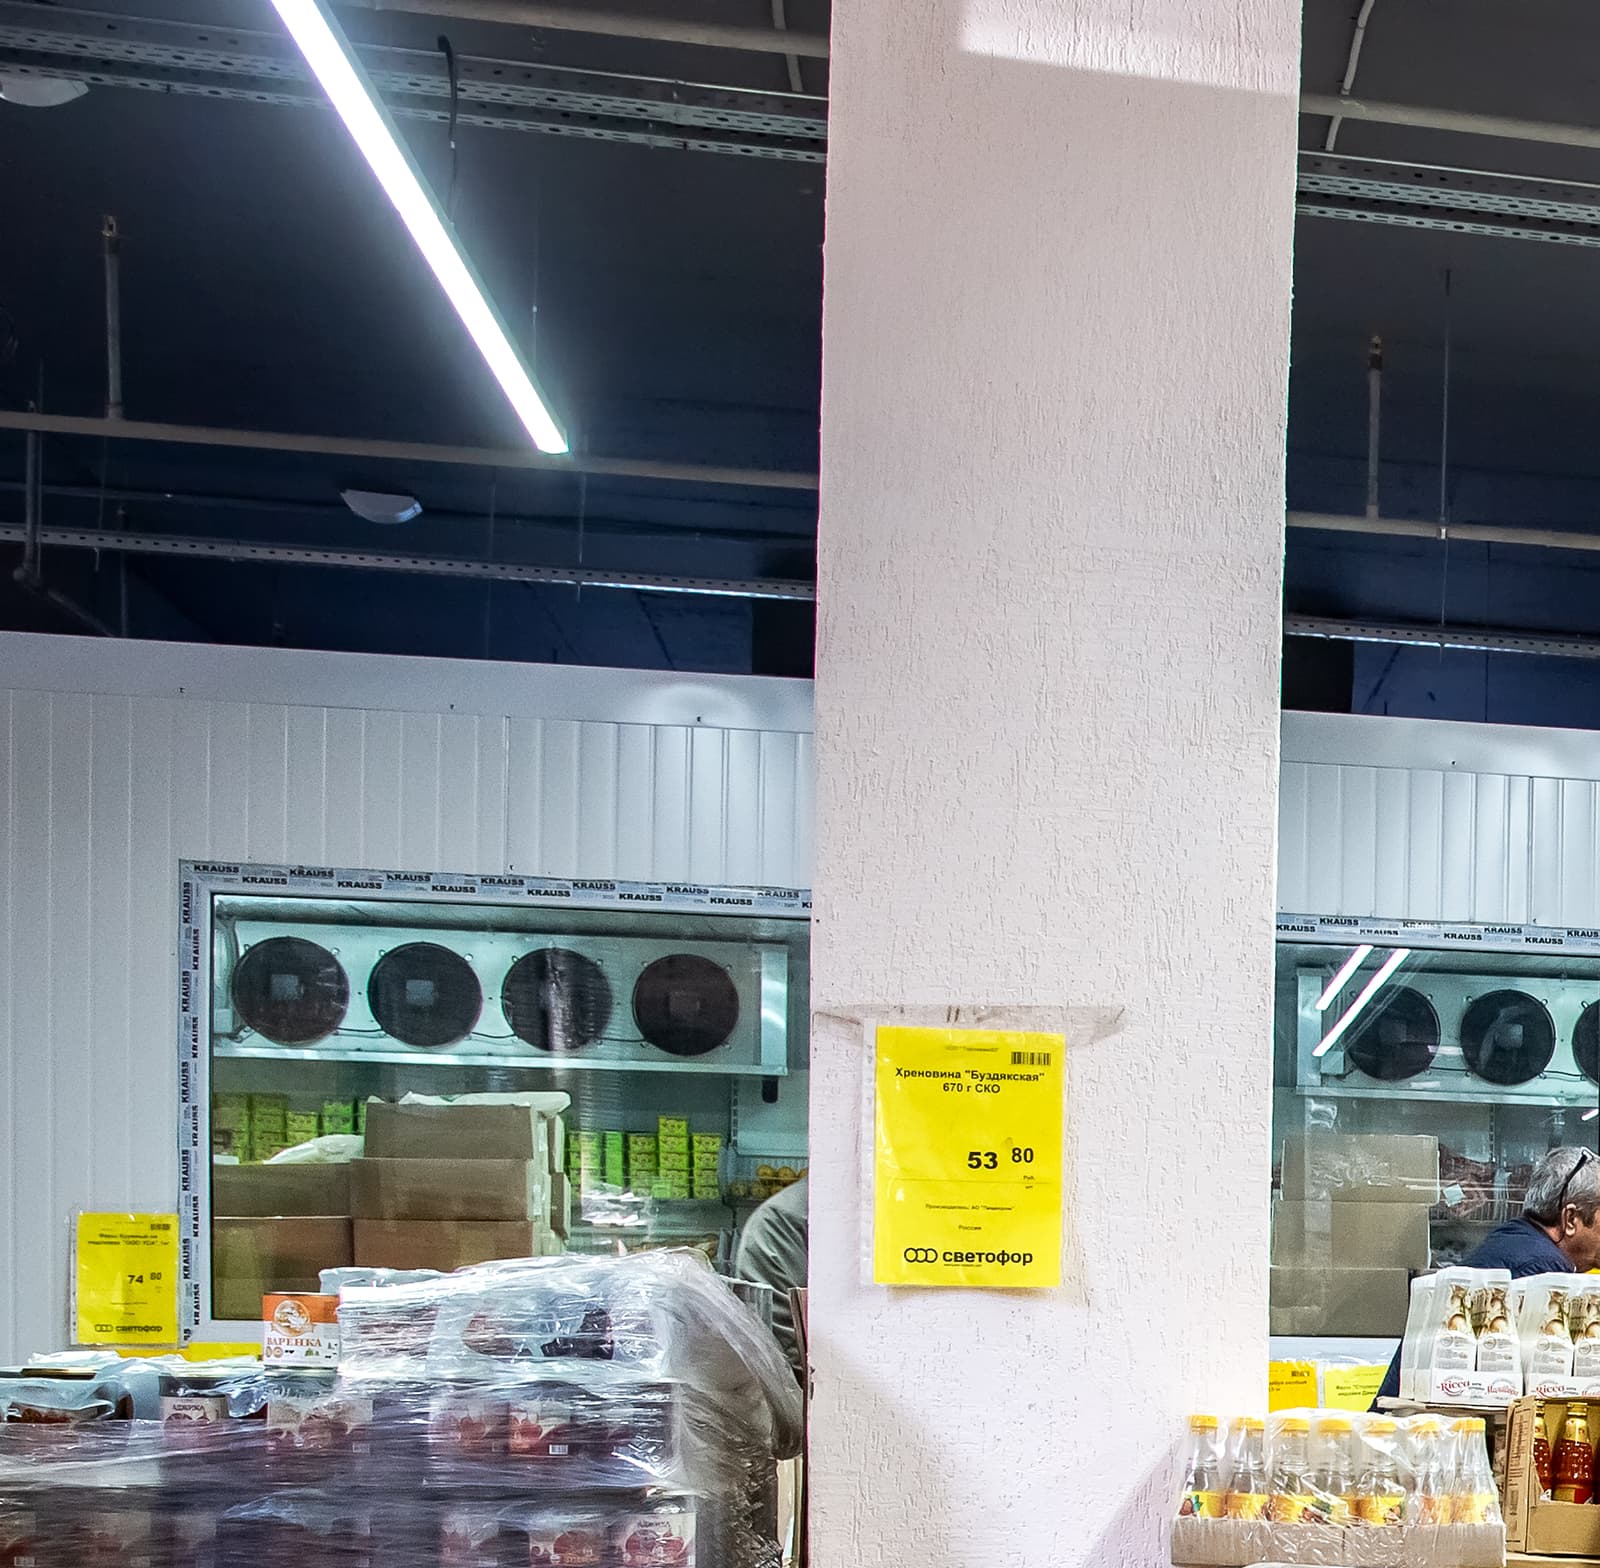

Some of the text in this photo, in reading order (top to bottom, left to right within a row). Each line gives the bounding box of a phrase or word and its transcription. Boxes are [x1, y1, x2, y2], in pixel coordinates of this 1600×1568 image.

[194, 864, 240, 874] KRAUSS
[290, 868, 334, 878] KRAUSS
[242, 876, 288, 885] KRAUSS
[387, 874, 431, 882] KRAUSS
[481, 877, 524, 886] KRAUSS
[338, 880, 382, 889] KRAUSS
[432, 885, 476, 893] KRAUSS
[573, 881, 615, 890] KRAUSS
[527, 889, 570, 897] KRAUSS
[666, 886, 709, 894] KRAUSS
[619, 893, 662, 901] KRAUSS
[710, 897, 753, 905] KRAUSS
[182, 881, 190, 923] KRAUSS
[1320, 918, 1358, 926] KRAUSS
[1277, 924, 1316, 932] KRAUSS
[1525, 937, 1563, 945] KRAUSS
[182, 971, 190, 1012] KRAUSS
[895, 1067, 1045, 1082] Хреновина "Буздякская"
[181, 1061, 189, 1103] KRAUSS
[943, 1083, 1000, 1093] 670 г СКО
[967, 1148, 1034, 1169] 53 80
[943, 1250, 1033, 1267] светофор
[128, 1274, 144, 1284] 74
[267, 1337, 321, 1347] ВАРЕНКА
[1440, 1380, 1471, 1392] Ricco
